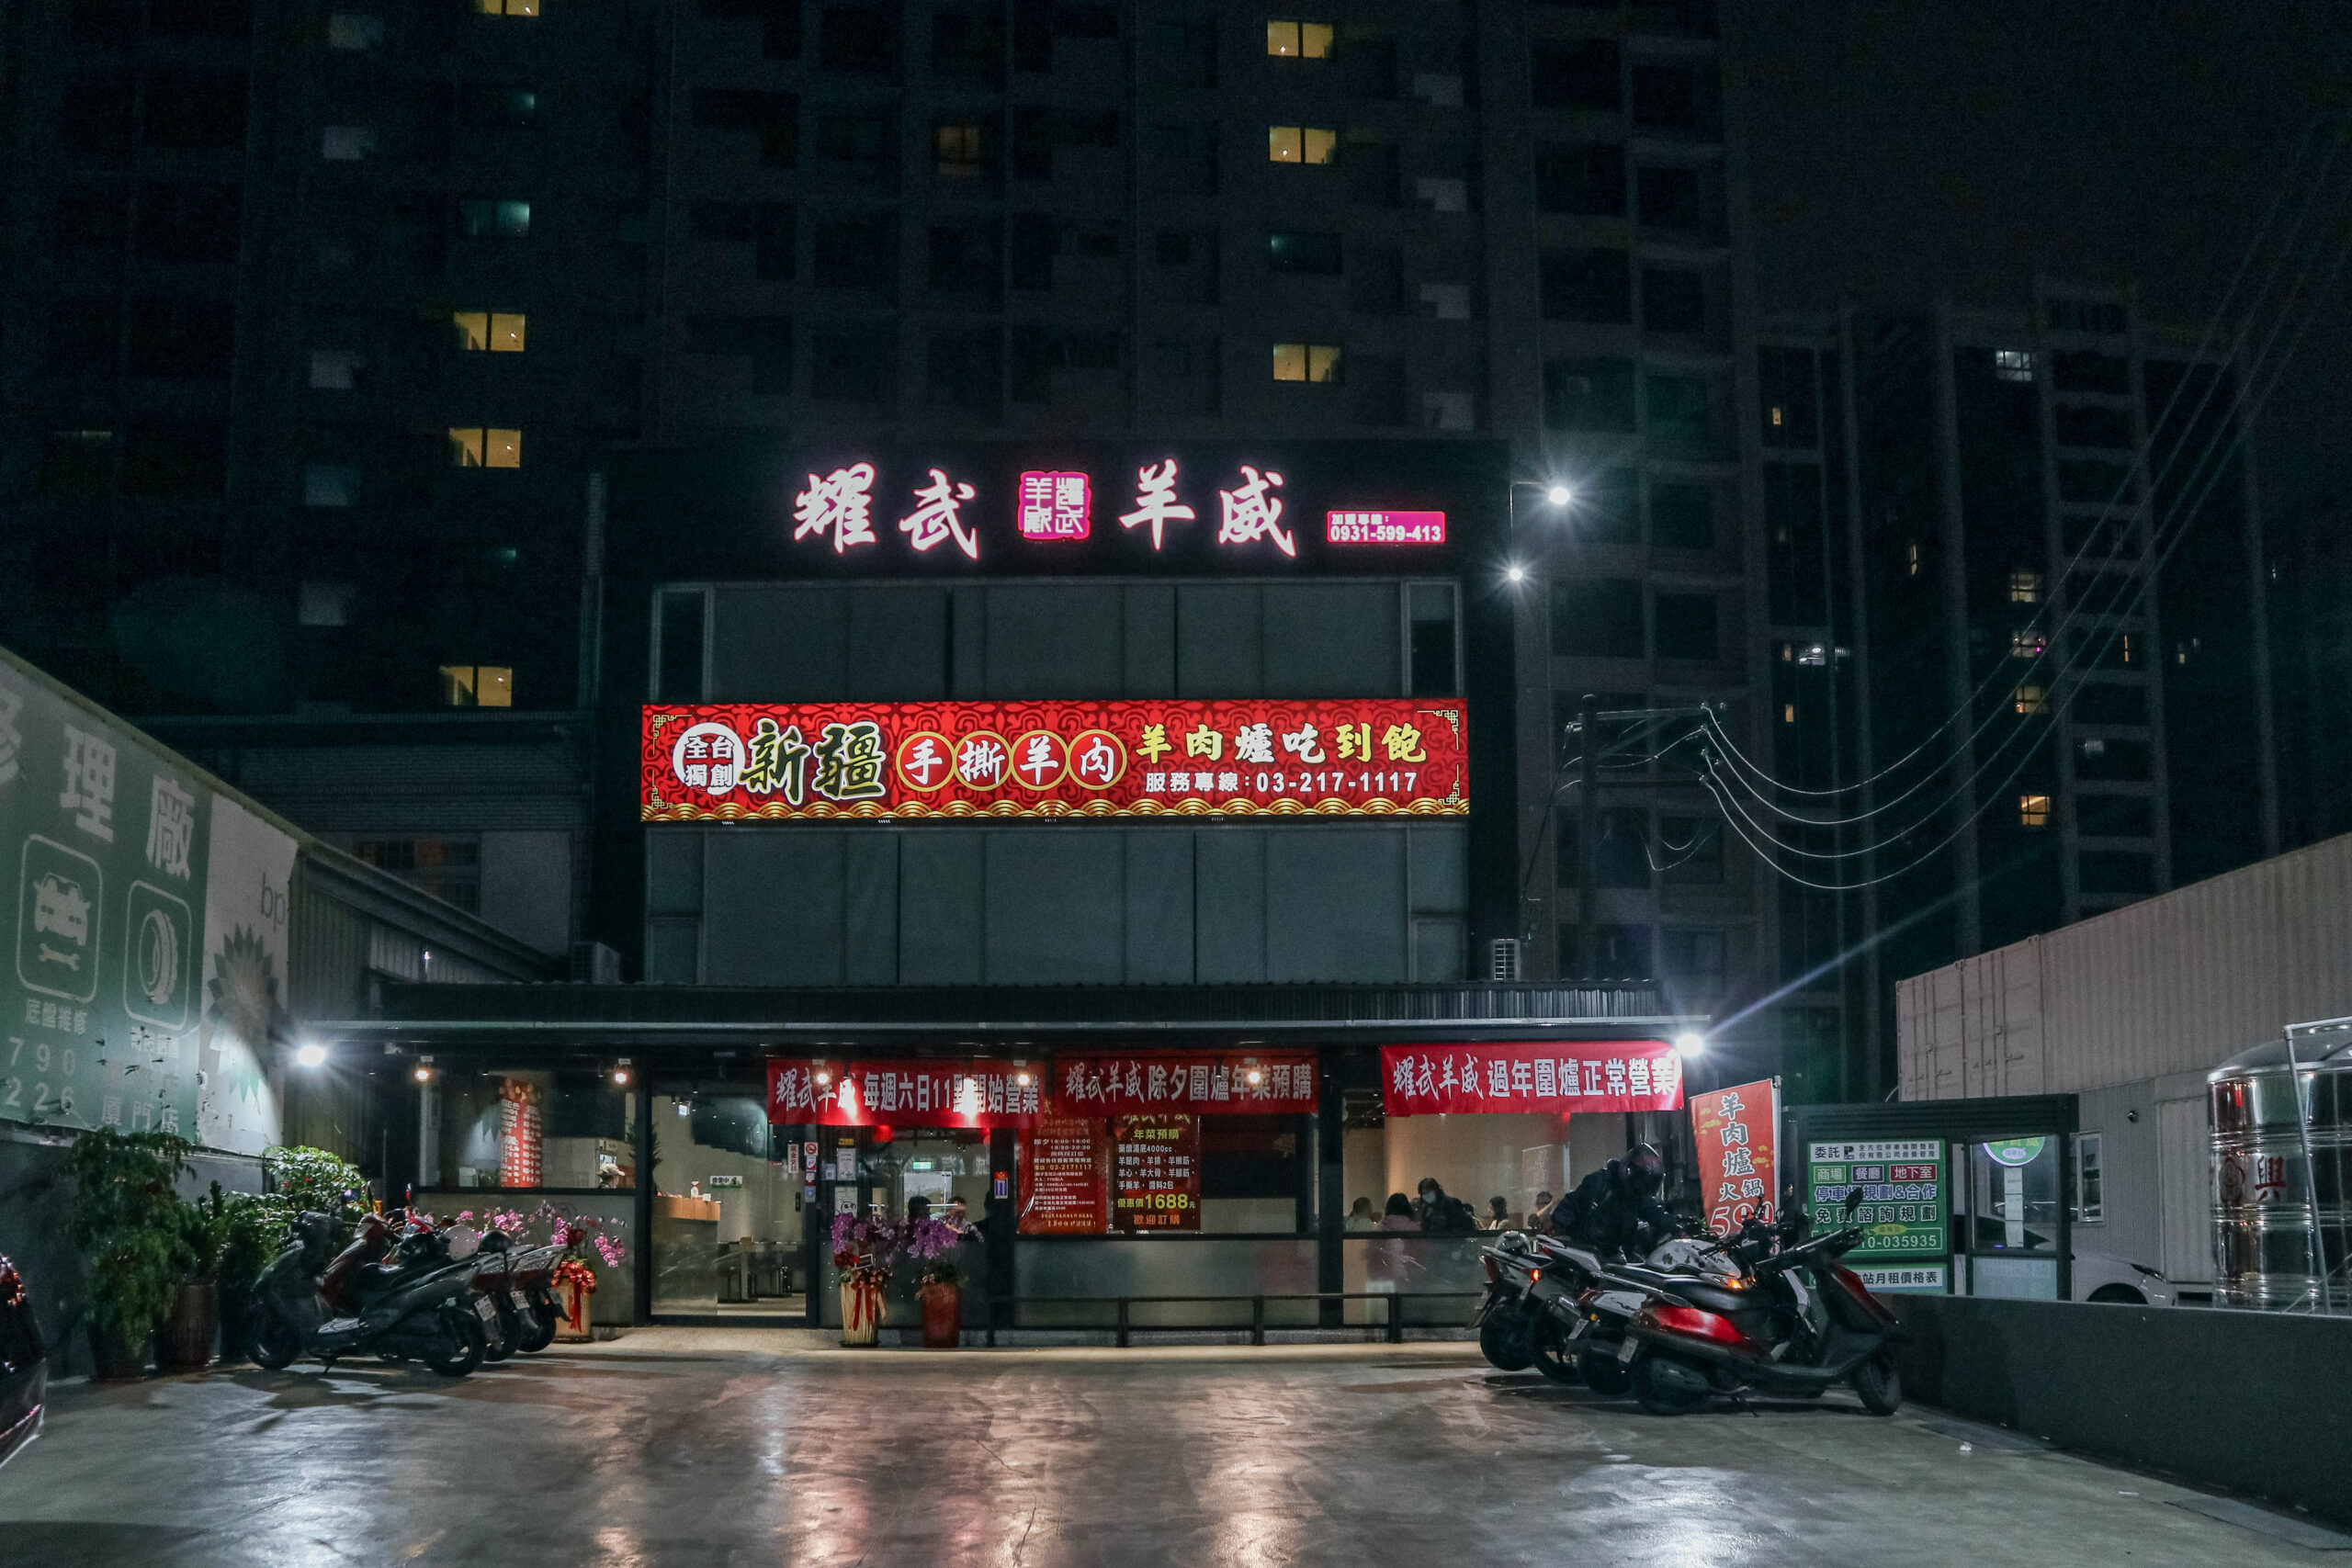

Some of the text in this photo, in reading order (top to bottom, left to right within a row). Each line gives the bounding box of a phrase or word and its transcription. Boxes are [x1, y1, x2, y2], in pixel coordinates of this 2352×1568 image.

[793, 458, 1296, 559] 耀武 羊威
[1330, 525, 1441, 540] 0931-599-413
[684, 736, 734, 760] 全台
[1136, 722, 1427, 763] 羊肉爐吃到飽
[740, 717, 885, 806] 新疆
[904, 734, 1115, 785] 手撕羊肉
[684, 763, 734, 788] 獨創
[261, 872, 287, 932] bp
[1134, 1129, 1180, 1139] 年菜預購
[1718, 1092, 1756, 1178] 羊肉爐
[1815, 1146, 1840, 1158] 委託
[1817, 1166, 1932, 1180] 商場 餐廳 地下室
[1718, 1179, 1765, 1201] 火鍋
[1860, 1271, 1938, 1284] 站月租價格表
